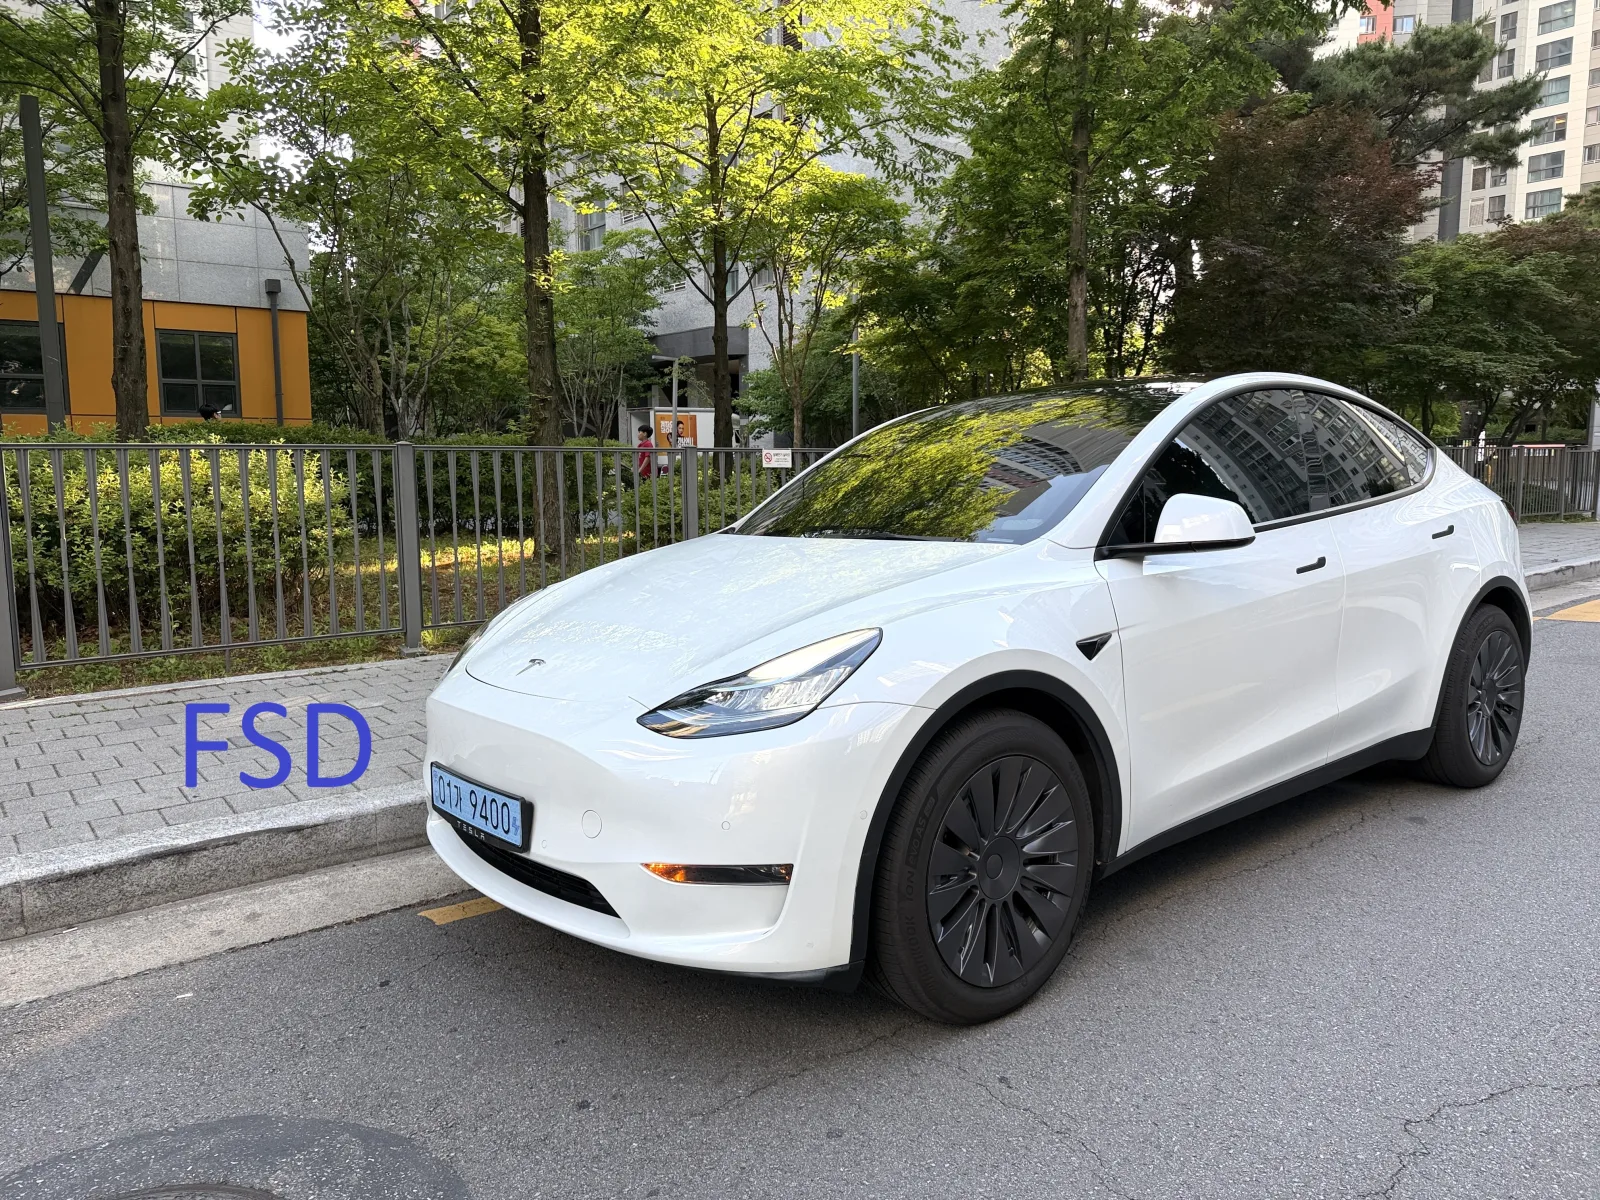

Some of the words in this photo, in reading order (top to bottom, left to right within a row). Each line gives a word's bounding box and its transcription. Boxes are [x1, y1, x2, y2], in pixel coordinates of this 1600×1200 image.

[438, 775, 462, 812] 01가
[469, 789, 510, 834] 9400
[457, 821, 485, 841] TESLA
